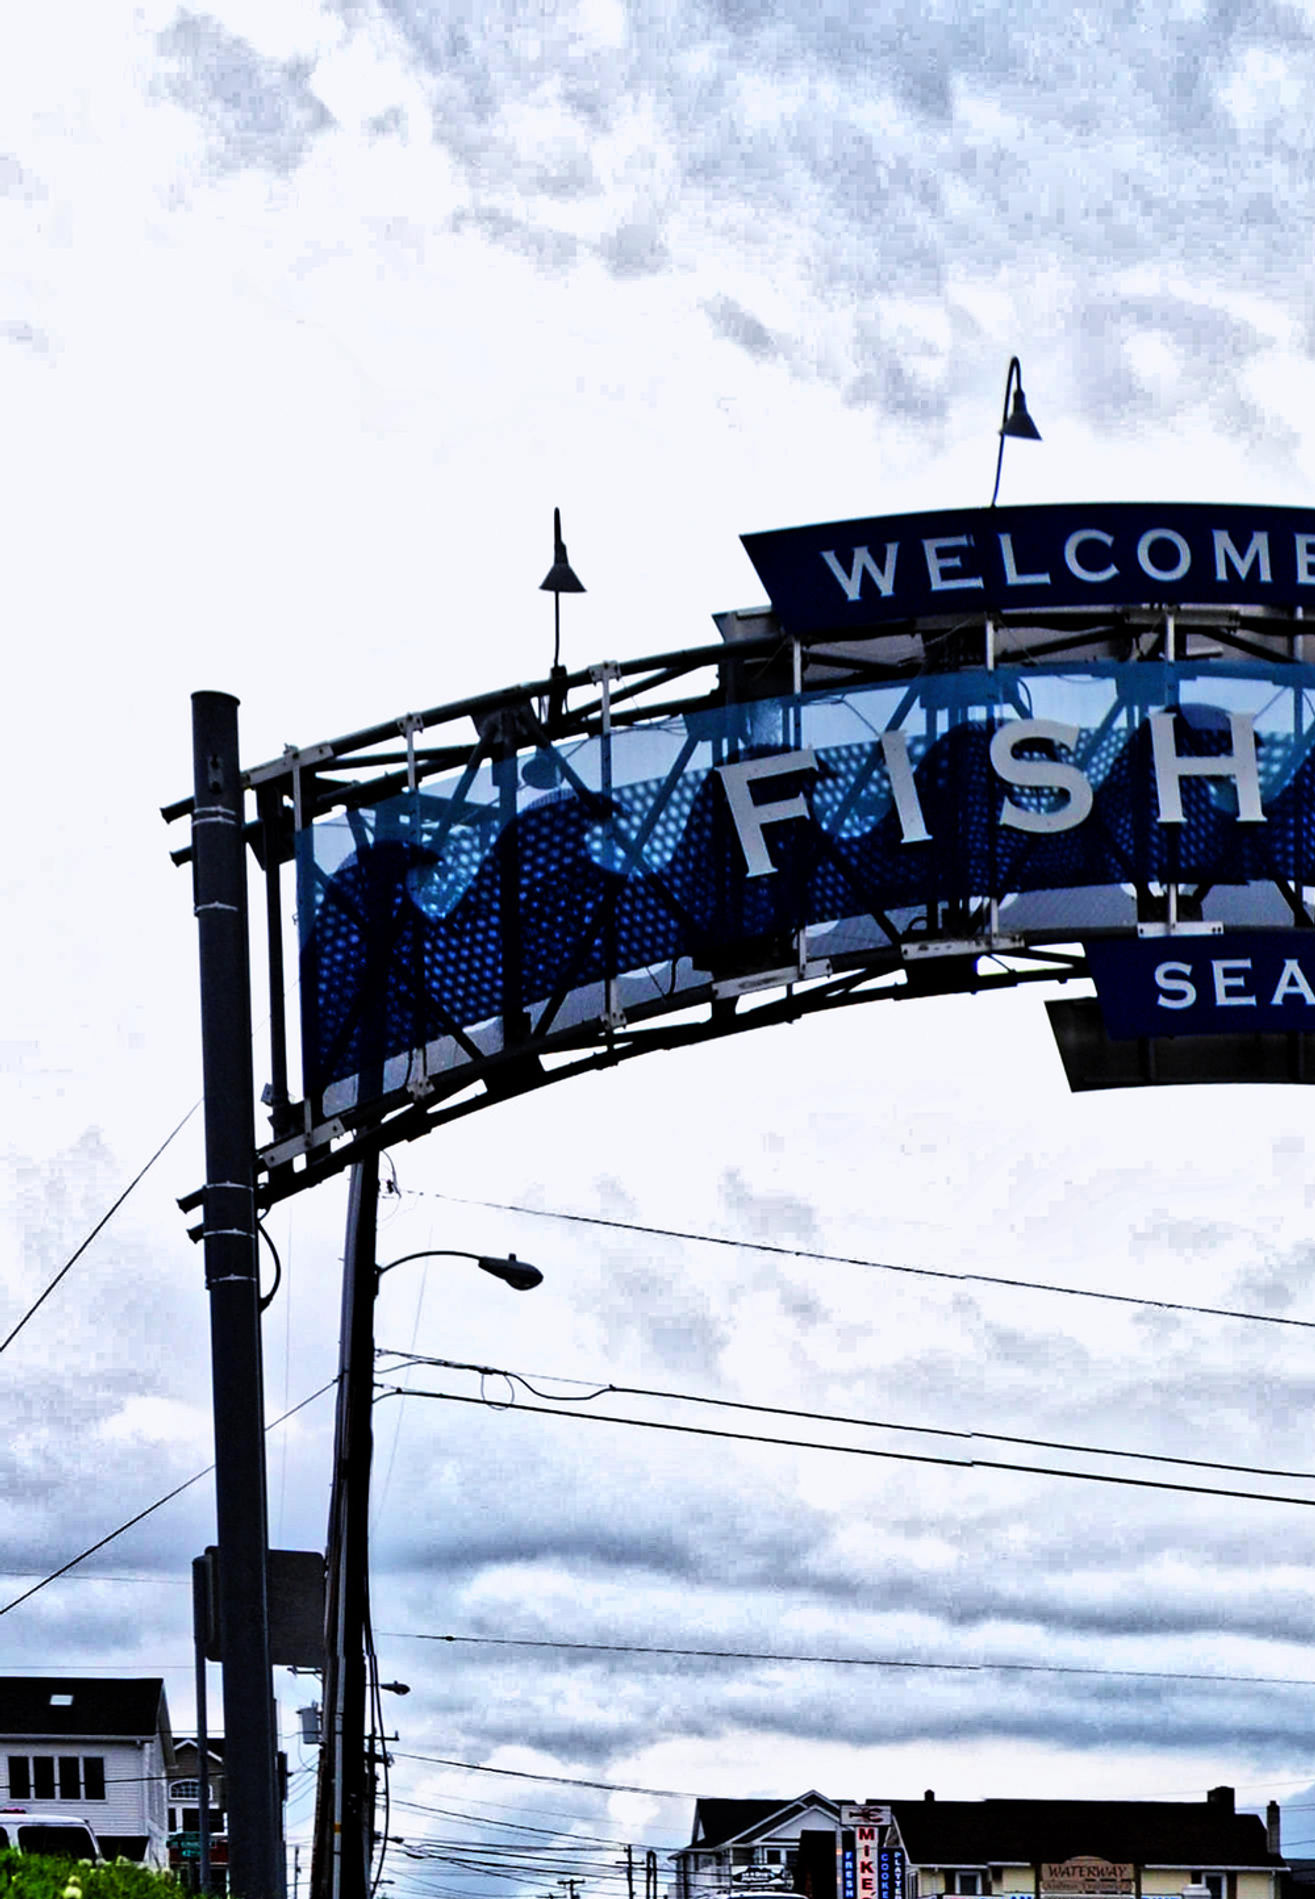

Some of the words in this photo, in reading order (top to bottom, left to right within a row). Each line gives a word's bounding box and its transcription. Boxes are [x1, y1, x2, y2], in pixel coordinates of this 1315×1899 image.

[715, 711, 1268, 878] FISH
[845, 1851, 854, 1898] FRESH
[1048, 1865, 1127, 1878] WATERWAY
